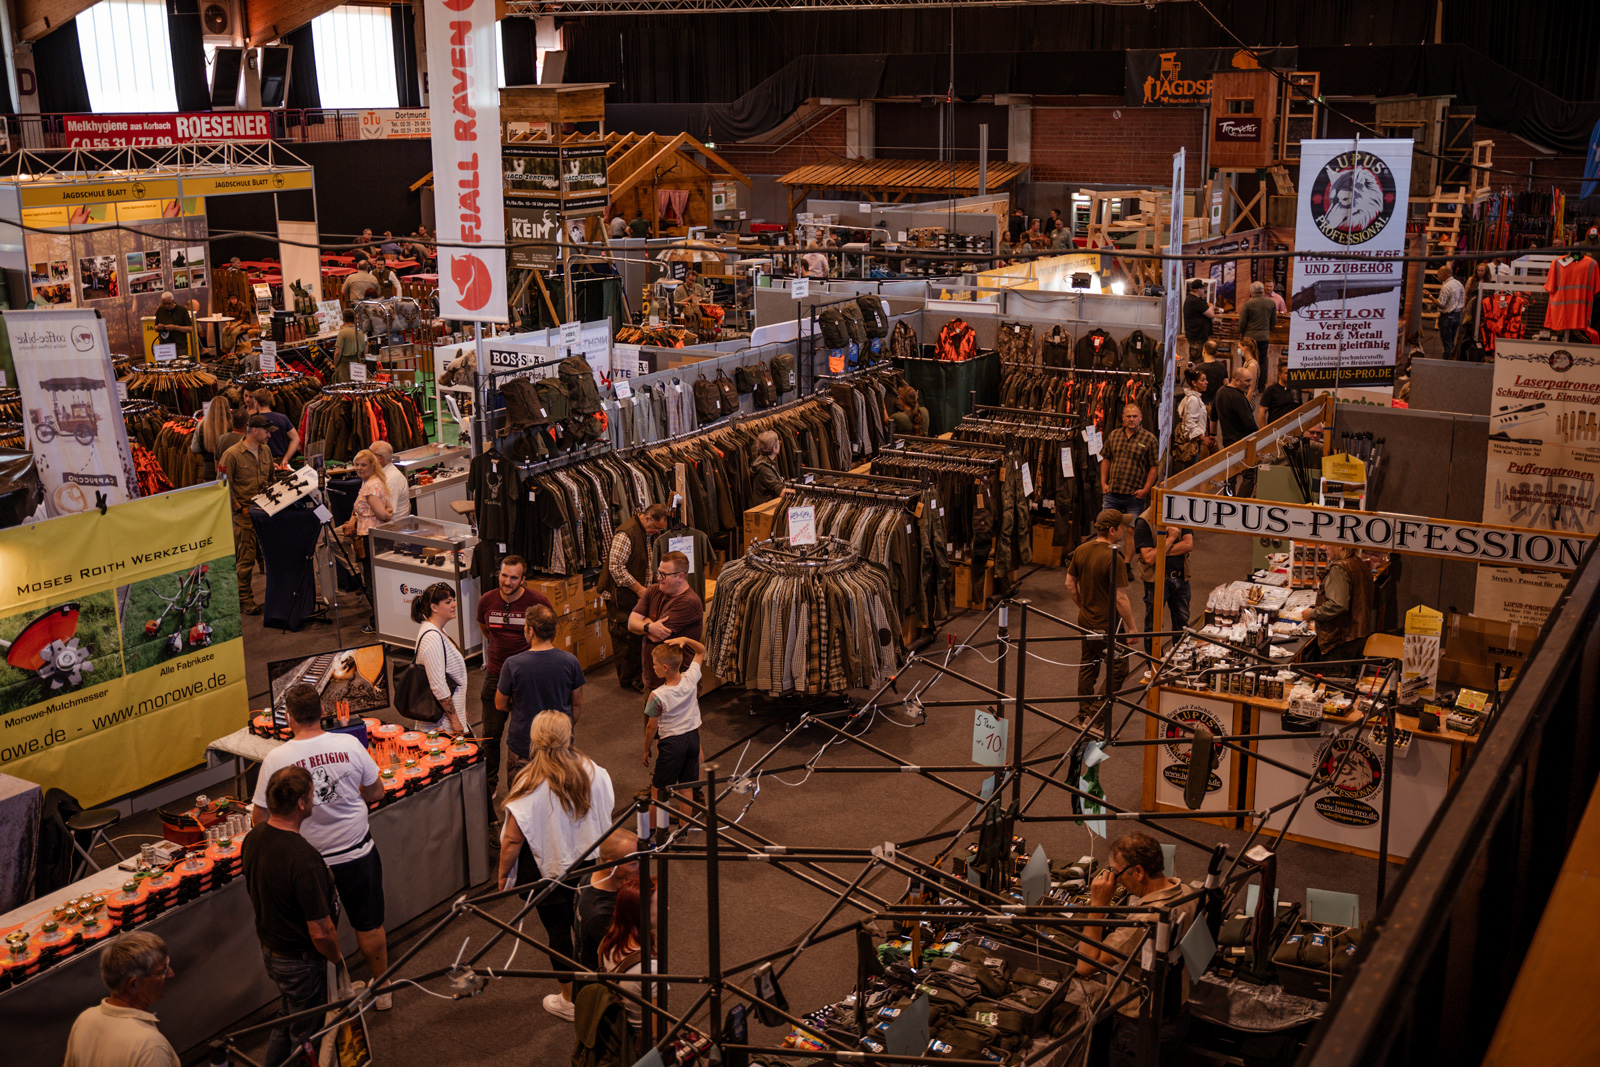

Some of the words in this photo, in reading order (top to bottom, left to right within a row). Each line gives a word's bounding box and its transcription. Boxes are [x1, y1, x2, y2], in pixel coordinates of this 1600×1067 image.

[17, 68, 36, 96] D
[449, 20, 478, 142] RÄVEN
[395, 111, 427, 119] Dortmund
[67, 120, 128, 133] Melkhygiene
[129, 123, 142, 131] aus
[143, 121, 171, 131] Korbach
[175, 115, 268, 138] ROESENER
[1325, 152, 1386, 175] LUPUS
[215, 180, 250, 188] JAGDSCHULE
[252, 178, 268, 186] BLATT
[62, 189, 105, 200] JAGDSCHULE
[107, 188, 127, 197] BLATT
[457, 152, 482, 244] FJÄLL
[512, 222, 550, 239] KEIM
[1315, 214, 1389, 244] PROFESSIONAL
[1305, 264, 1330, 274] UND
[1333, 262, 1393, 274] ZUBEHÖR
[1305, 308, 1386, 319] TEFLON
[1318, 321, 1371, 332] Versiegelt
[1305, 332, 1332, 341] Holz
[1334, 332, 1344, 340] &
[1348, 331, 1383, 340] Metall
[1296, 342, 1337, 351] Extrem
[1340, 340, 1390, 351] gleitfähig
[1302, 354, 1384, 362] Hochleistungsschmierstoffe
[1290, 368, 1392, 381] WWW.LUPUS-PRO.DE
[1496, 387, 1553, 400] Schußprüfer,
[1507, 461, 1595, 481] Pufferpatronen
[17, 573, 73, 596] MOSES
[80, 560, 125, 579] ROITH
[131, 536, 214, 566] WERKZEUGE
[1491, 574, 1513, 582] Stretch
[1519, 578, 1543, 588] Passend
[160, 665, 175, 677] Alle
[176, 653, 215, 671] Fabrikate
[4, 688, 109, 729] Morowe-Mulchmesser
[92, 672, 227, 730] www.morowe.de
[308, 751, 350, 768] RELIGION
[1316, 802, 1378, 820] www.lupus-pro.de
